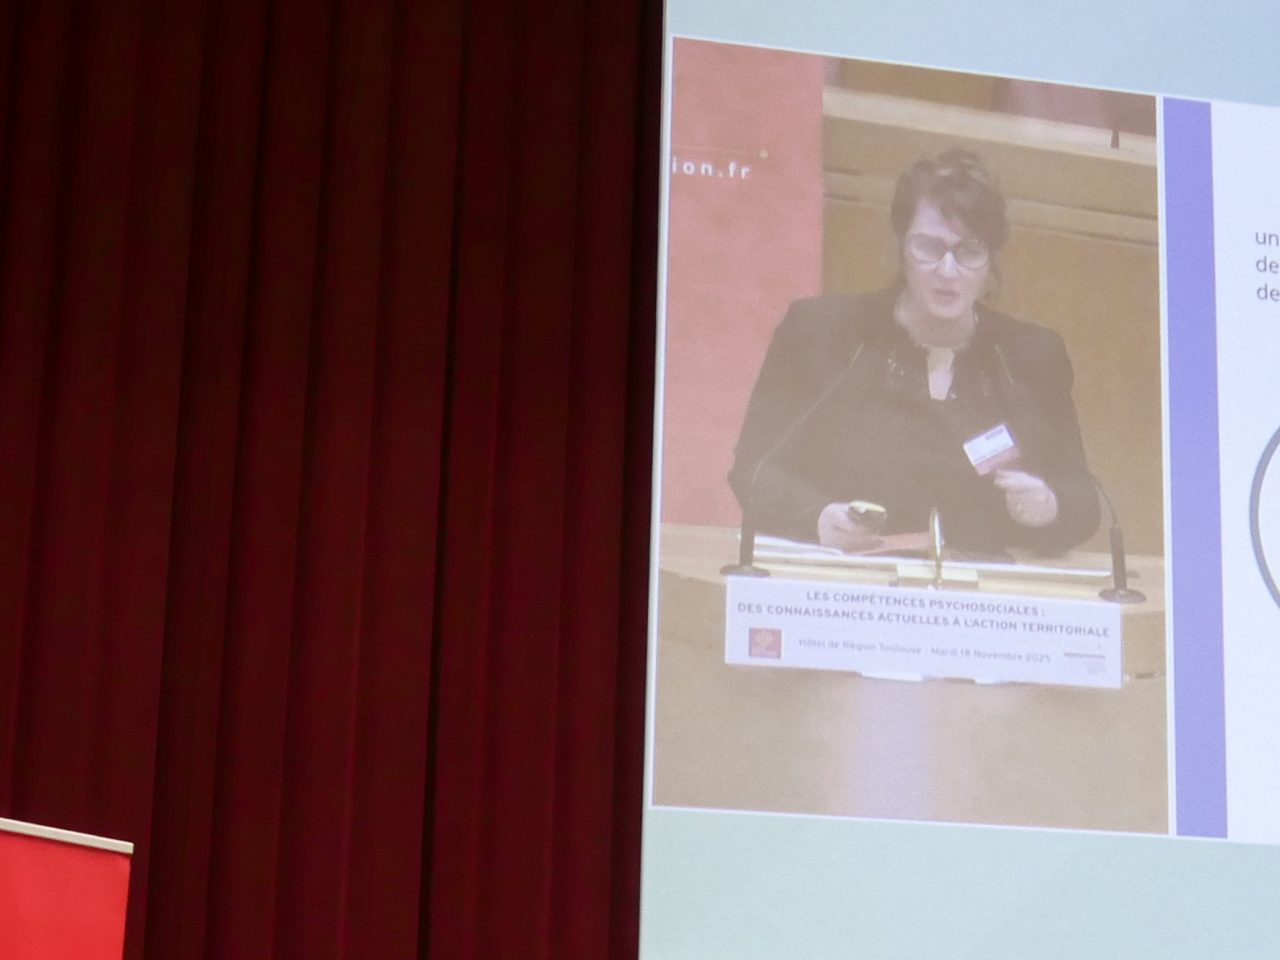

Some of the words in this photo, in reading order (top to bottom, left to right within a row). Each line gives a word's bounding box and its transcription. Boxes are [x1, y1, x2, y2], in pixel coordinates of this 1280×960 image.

[1255, 231, 1279, 247] un
[1256, 256, 1279, 273] de
[806, 591, 829, 602] LES
[833, 592, 925, 608] COMPÉTENCES
[929, 600, 1039, 616] PSYCHOSOCIALES
[738, 603, 763, 613] DES
[767, 605, 874, 621] CONNAISSANCES
[878, 612, 949, 626] ACTUELLES
[1022, 623, 1110, 637] TERRITORIALE
